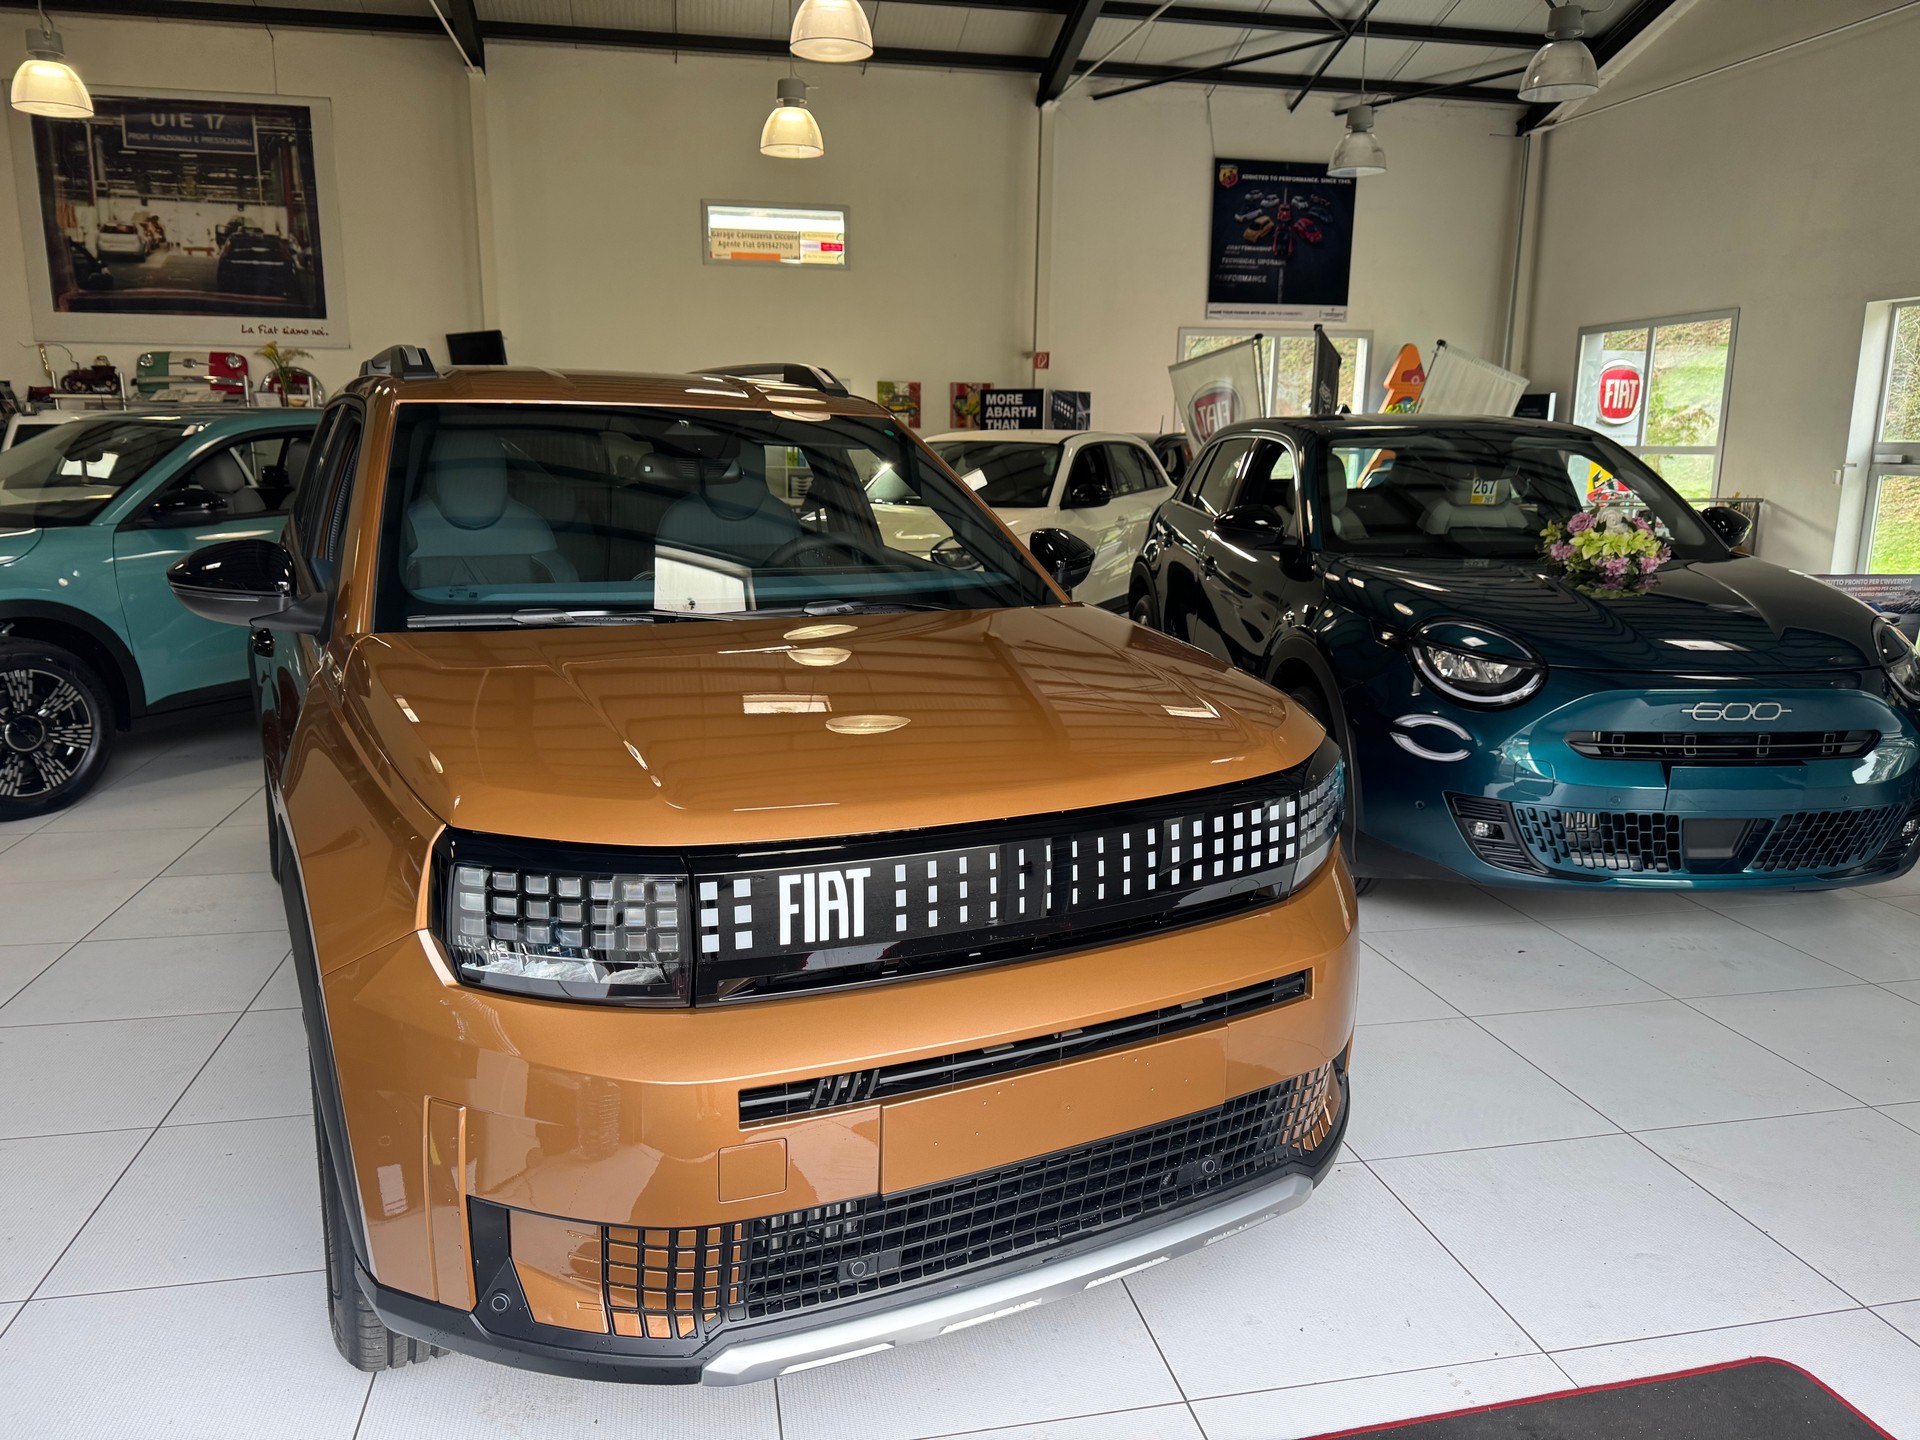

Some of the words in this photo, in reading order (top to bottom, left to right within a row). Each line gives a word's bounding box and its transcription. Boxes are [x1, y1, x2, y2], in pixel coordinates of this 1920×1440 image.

[203, 113, 226, 130] 17
[737, 232, 772, 240] Carrozzeria
[718, 240, 741, 249] Agente
[742, 241, 756, 249] Fiat
[1222, 257, 1256, 265] TECHNICAL
[241, 324, 254, 334] La
[258, 324, 278, 334] Fiat
[282, 326, 309, 335] siamo
[985, 394, 1023, 405] MORE
[1603, 379, 1639, 409] FIAT
[985, 407, 1037, 418] ABARTH
[985, 420, 1019, 430] THAN
[1473, 478, 1496, 495] 267
[1691, 702, 1783, 721] 600
[778, 867, 871, 945] FIAT
